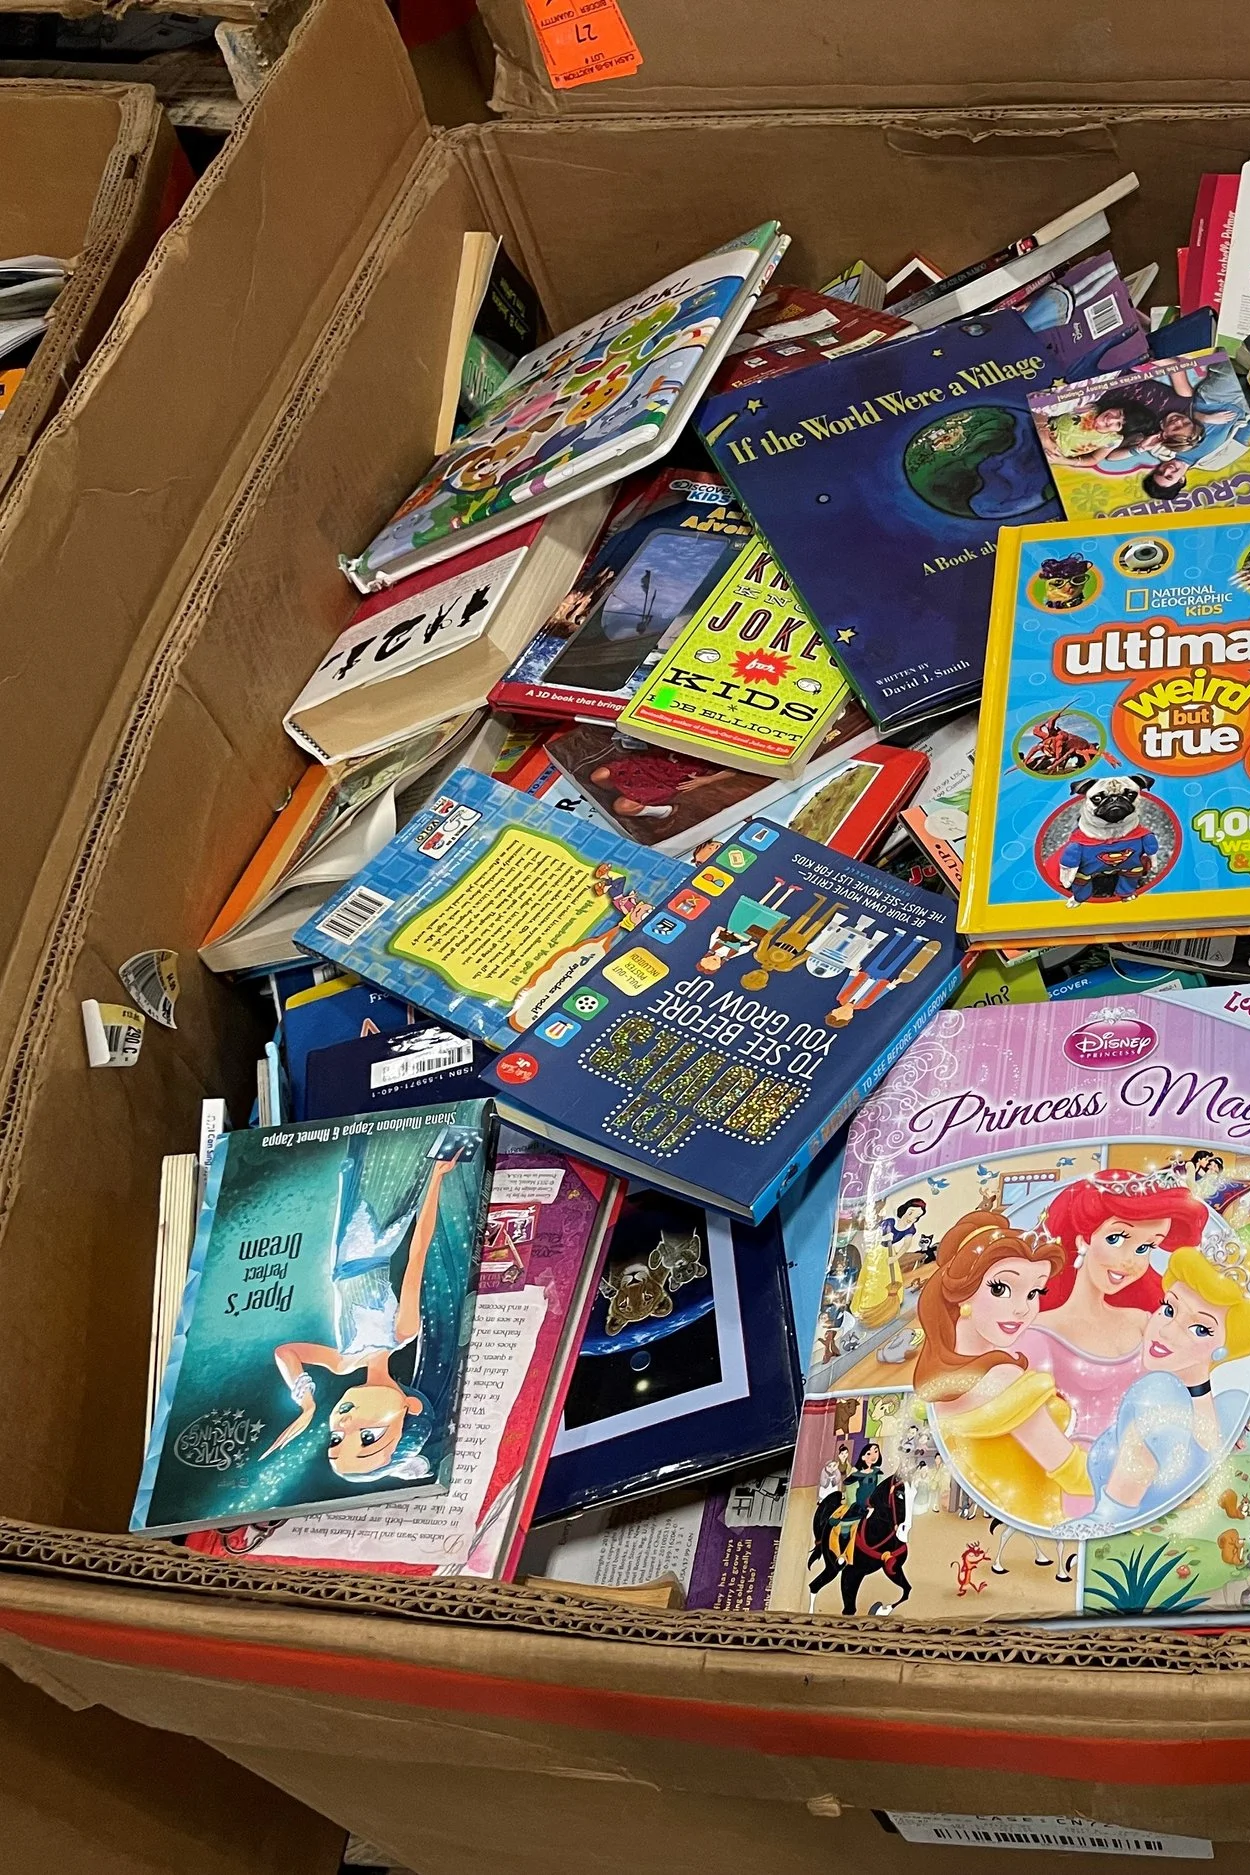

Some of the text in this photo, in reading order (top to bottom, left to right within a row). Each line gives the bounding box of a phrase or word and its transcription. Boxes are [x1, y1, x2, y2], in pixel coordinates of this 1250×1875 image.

[614, 53, 635, 65] CASH
[727, 353, 1046, 466] If the World Were a Village
[689, 490, 732, 504] KIDS
[937, 548, 977, 571] Book
[1151, 592, 1232, 609] GEOGRAPHIC
[1152, 584, 1216, 598] NATIONAL
[876, 668, 917, 687] WRITTEN
[881, 658, 972, 699] David Smith
[551, 692, 574, 704] book
[661, 666, 819, 723] KIDS
[699, 709, 803, 742] ELLIOTT
[1172, 706, 1211, 727] but
[1143, 725, 1240, 759] true
[791, 853, 816, 868] KIDS
[813, 862, 834, 877] FOR
[832, 869, 855, 885] LIST
[852, 879, 883, 899] MOVIE
[833, 884, 927, 928] BE YOUR OWN MOVIE
[881, 892, 927, 916] MUST-SEE
[928, 911, 947, 924] THE
[624, 961, 647, 981] POSTER
[629, 952, 661, 978] INCLUDED!
[674, 975, 838, 1056] YOU GROW UP
[647, 990, 824, 1080] TO SEE BEFORE
[887, 1012, 927, 1063] BEFORE YOU
[1084, 1049, 1136, 1059] PRINCESS
[448, 1065, 474, 1080] ISBN
[588, 1017, 803, 1138] MOVIES
[261, 1111, 457, 1149] Shana Muldoon Zappa Ahmet Zappa
[908, 1089, 1108, 1156] Princess
[238, 1232, 303, 1260] Dream
[242, 1262, 289, 1283] Perfect
[224, 1284, 295, 1318] Piper's
[395, 1531, 417, 1542] Swan
[718, 1538, 734, 1588] has always
[733, 1554, 742, 1575] grow
